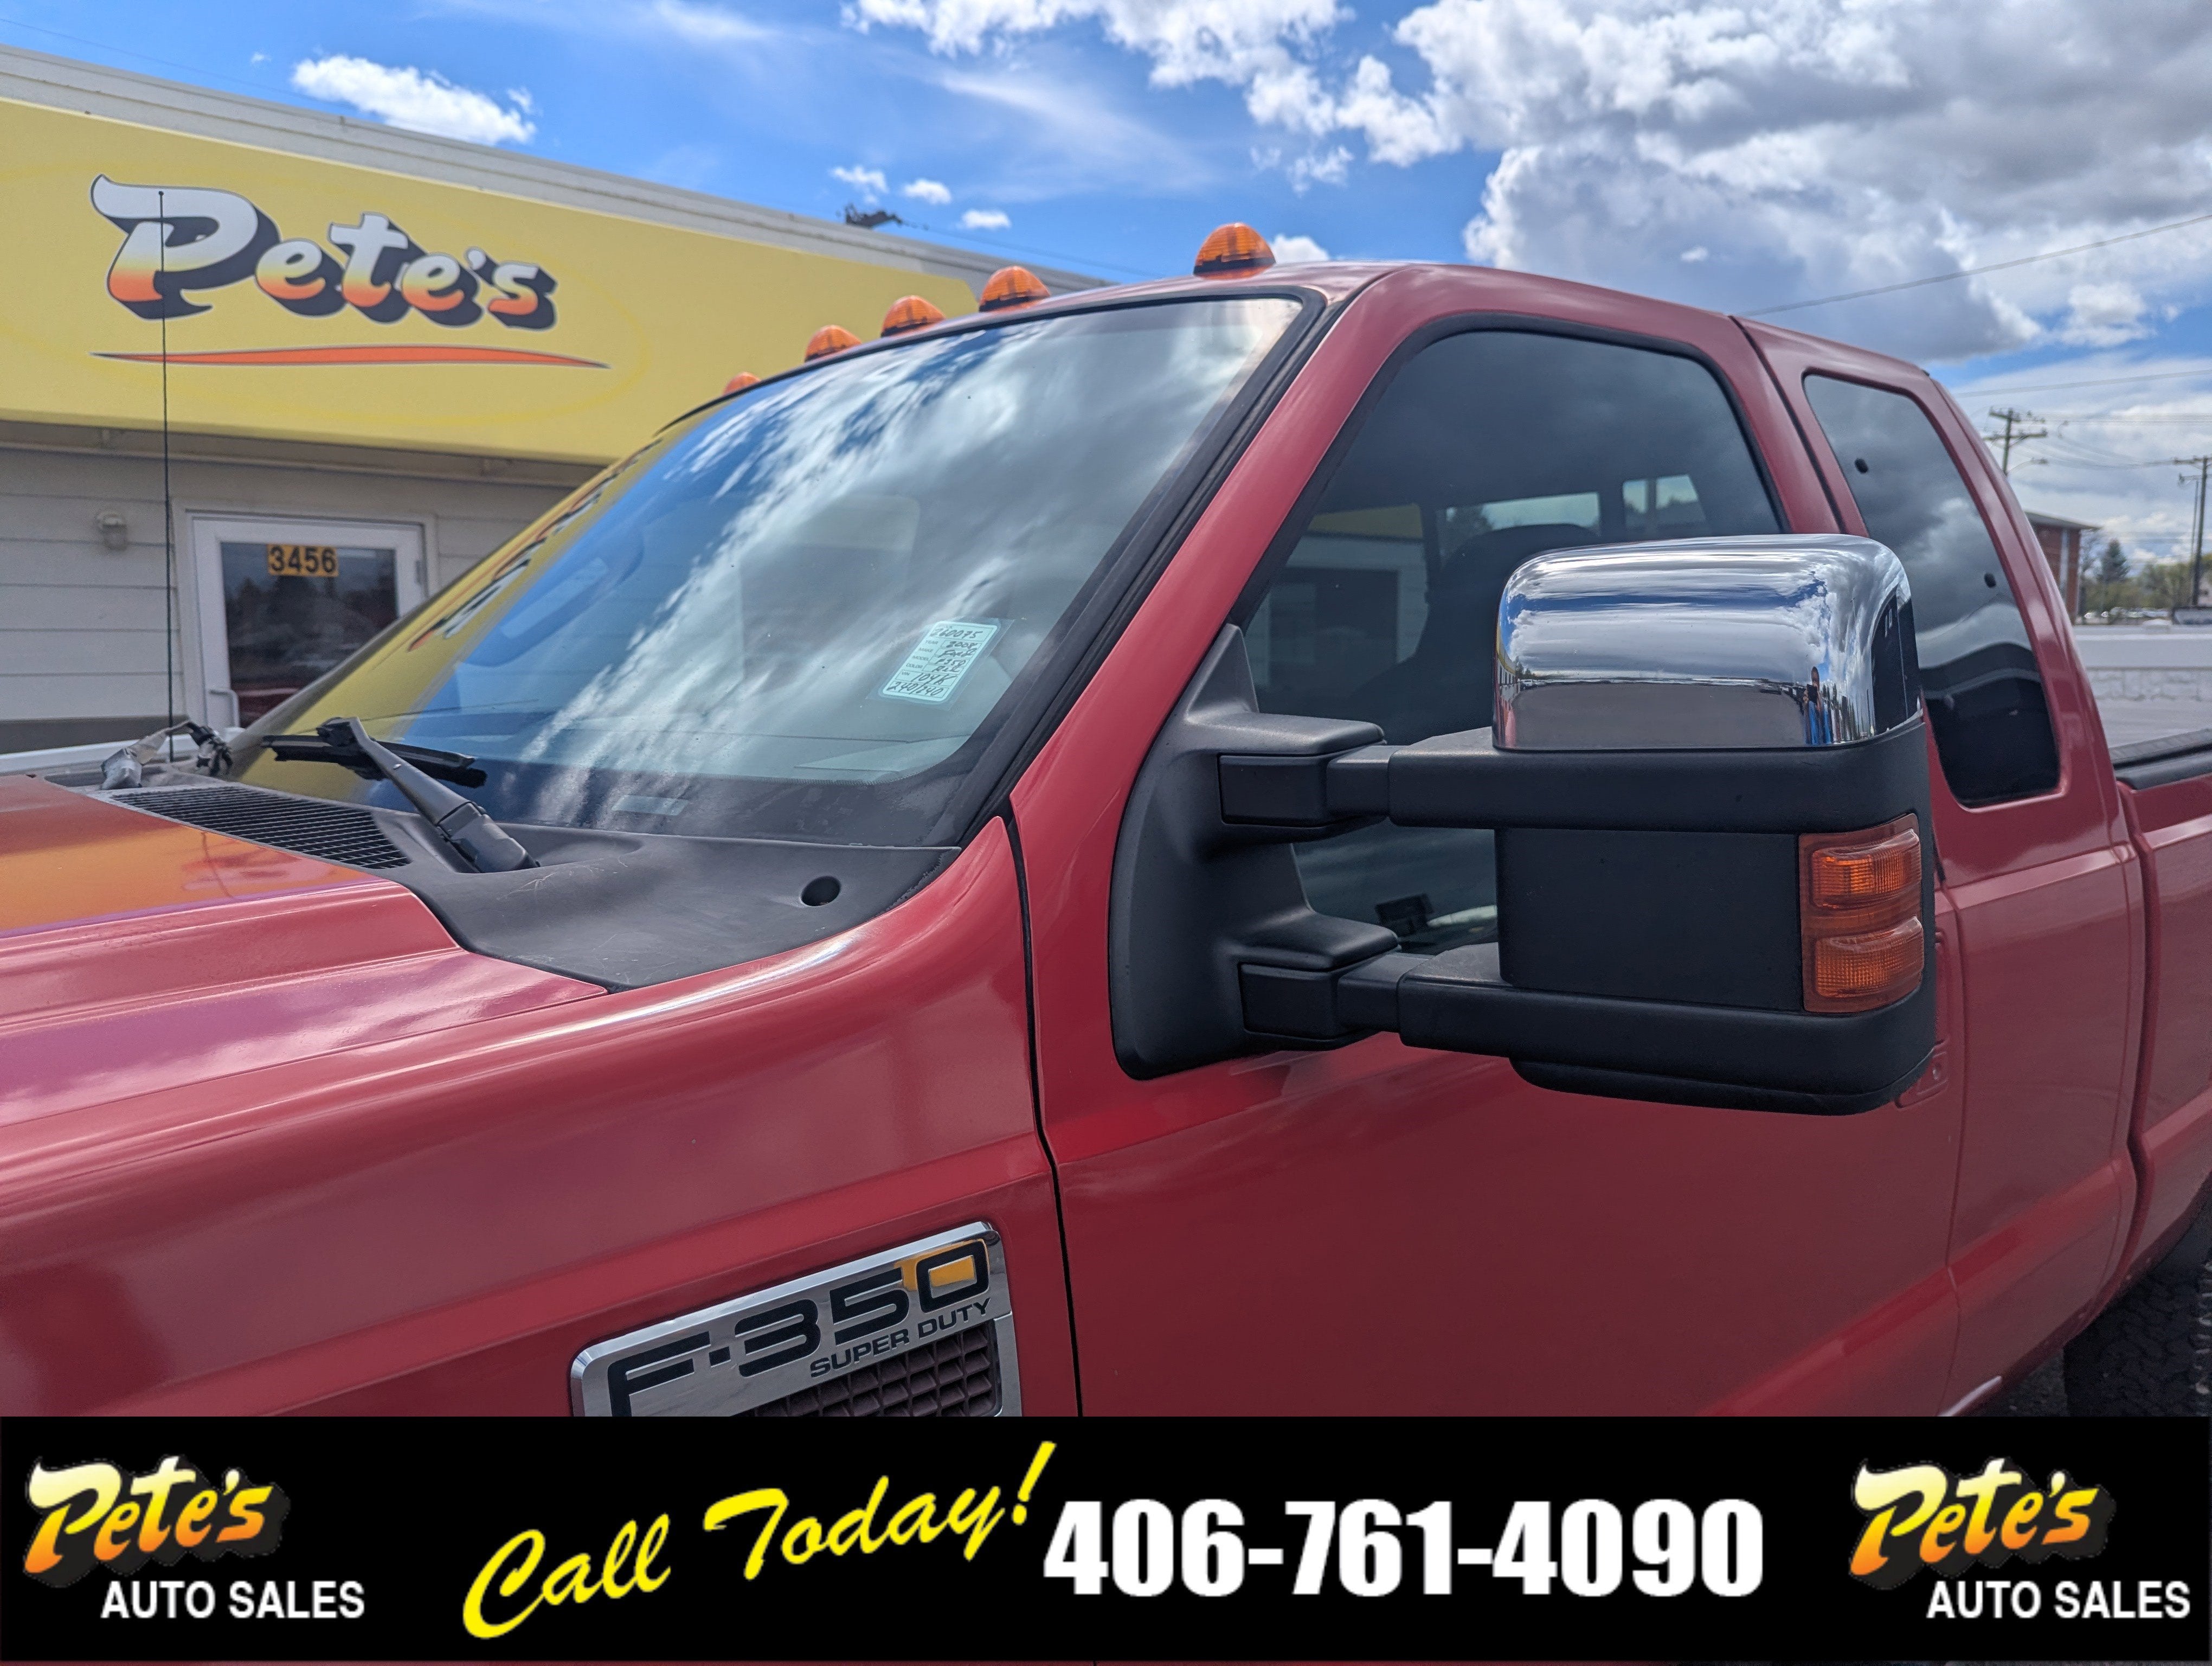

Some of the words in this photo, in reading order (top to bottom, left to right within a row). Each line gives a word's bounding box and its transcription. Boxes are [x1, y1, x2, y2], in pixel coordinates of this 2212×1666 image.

[91, 174, 557, 330] Pete's
[270, 546, 337, 573] 3456
[811, 1328, 910, 1378] SUPER
[918, 1298, 992, 1340] DUTY
